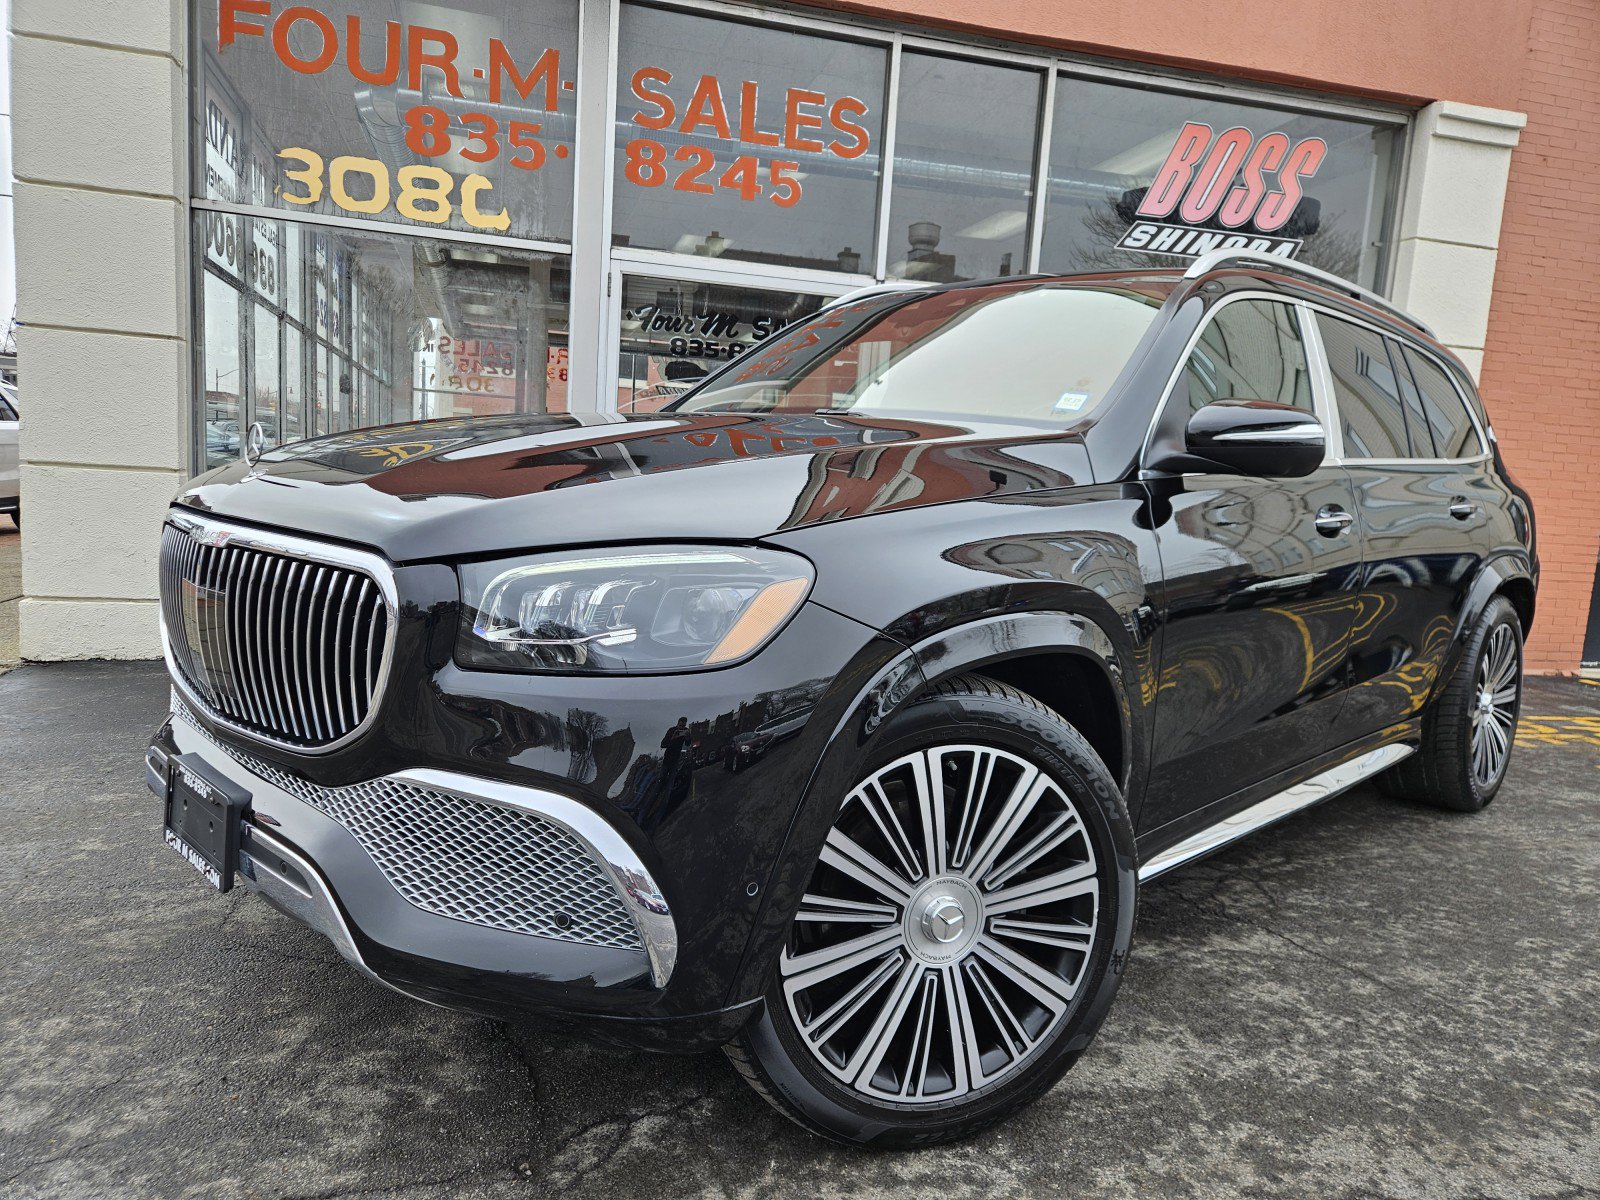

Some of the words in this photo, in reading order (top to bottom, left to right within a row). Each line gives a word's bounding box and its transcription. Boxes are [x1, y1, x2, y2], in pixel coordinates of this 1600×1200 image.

[631, 66, 870, 159] SALES
[624, 138, 803, 208] 8245
[1135, 121, 1328, 231] BOSS
[635, 303, 695, 335] Four
[696, 312, 739, 339] M
[1000, 711, 1120, 819] SCORPION
[1033, 745, 1085, 793] WINTER
[936, 880, 967, 889] MAYBACH
